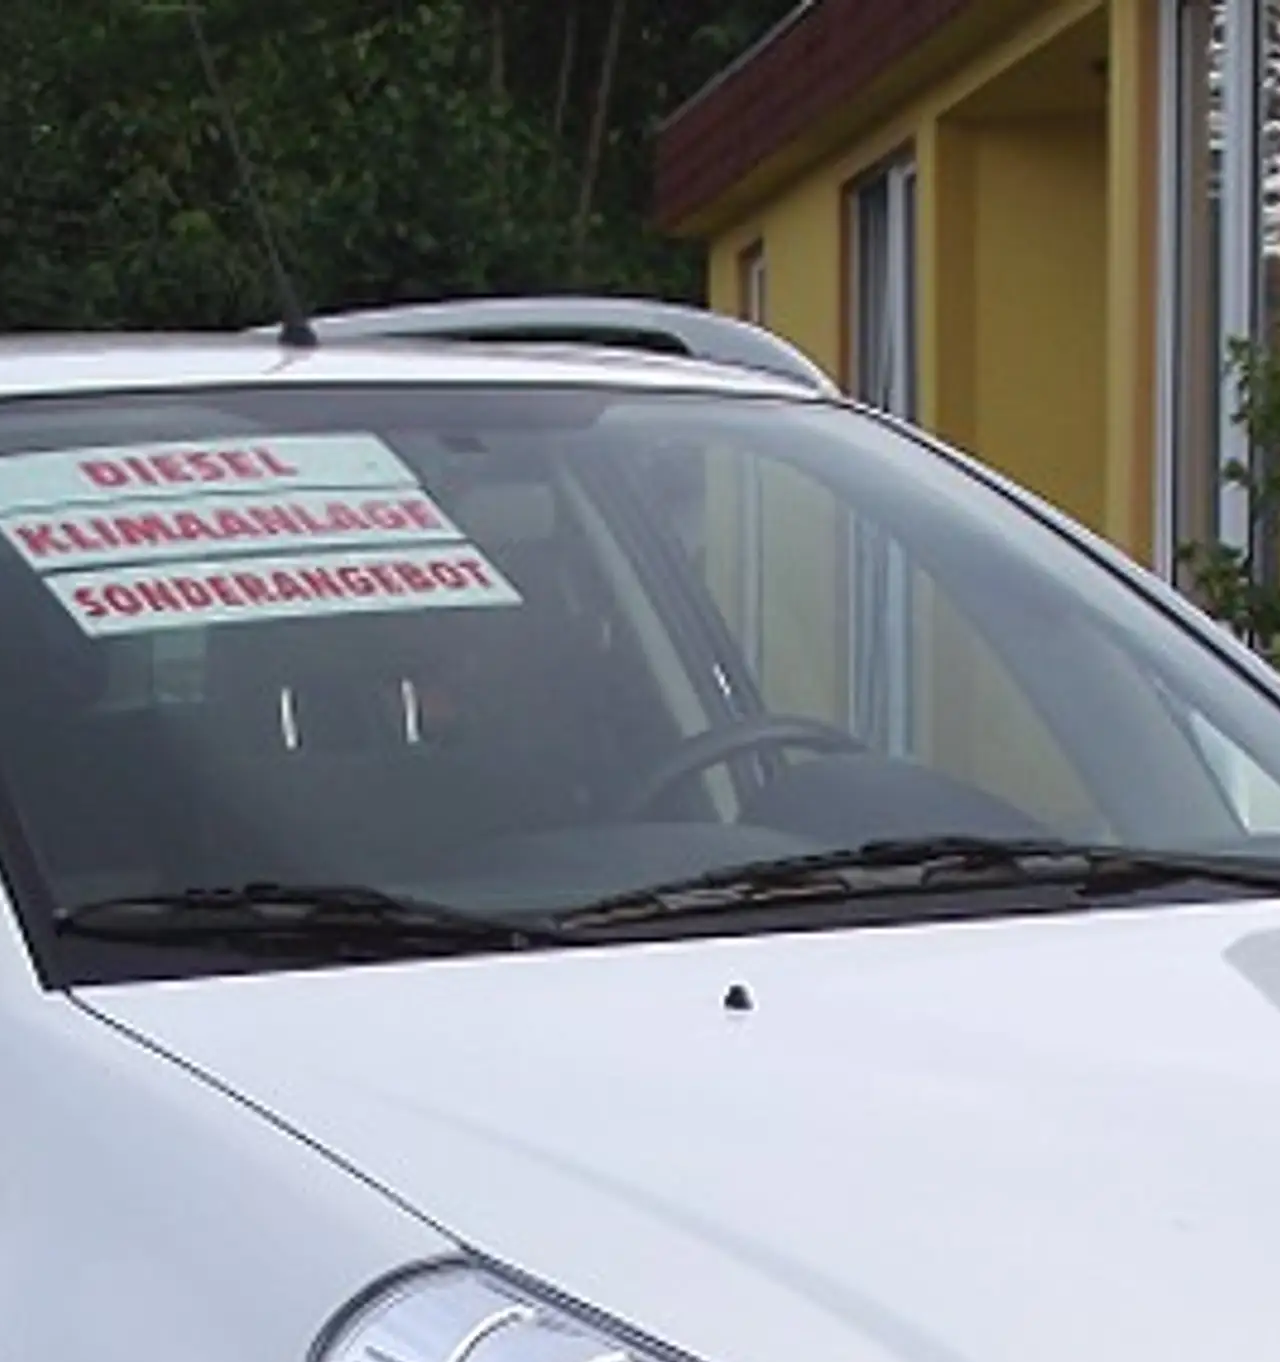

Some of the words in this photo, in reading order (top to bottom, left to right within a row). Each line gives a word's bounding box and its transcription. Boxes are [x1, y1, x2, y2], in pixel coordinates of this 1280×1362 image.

[79, 447, 296, 487] DIESEL
[15, 499, 445, 558] KLIMAANLAGE
[74, 558, 494, 617] SONDERANGEBOT
